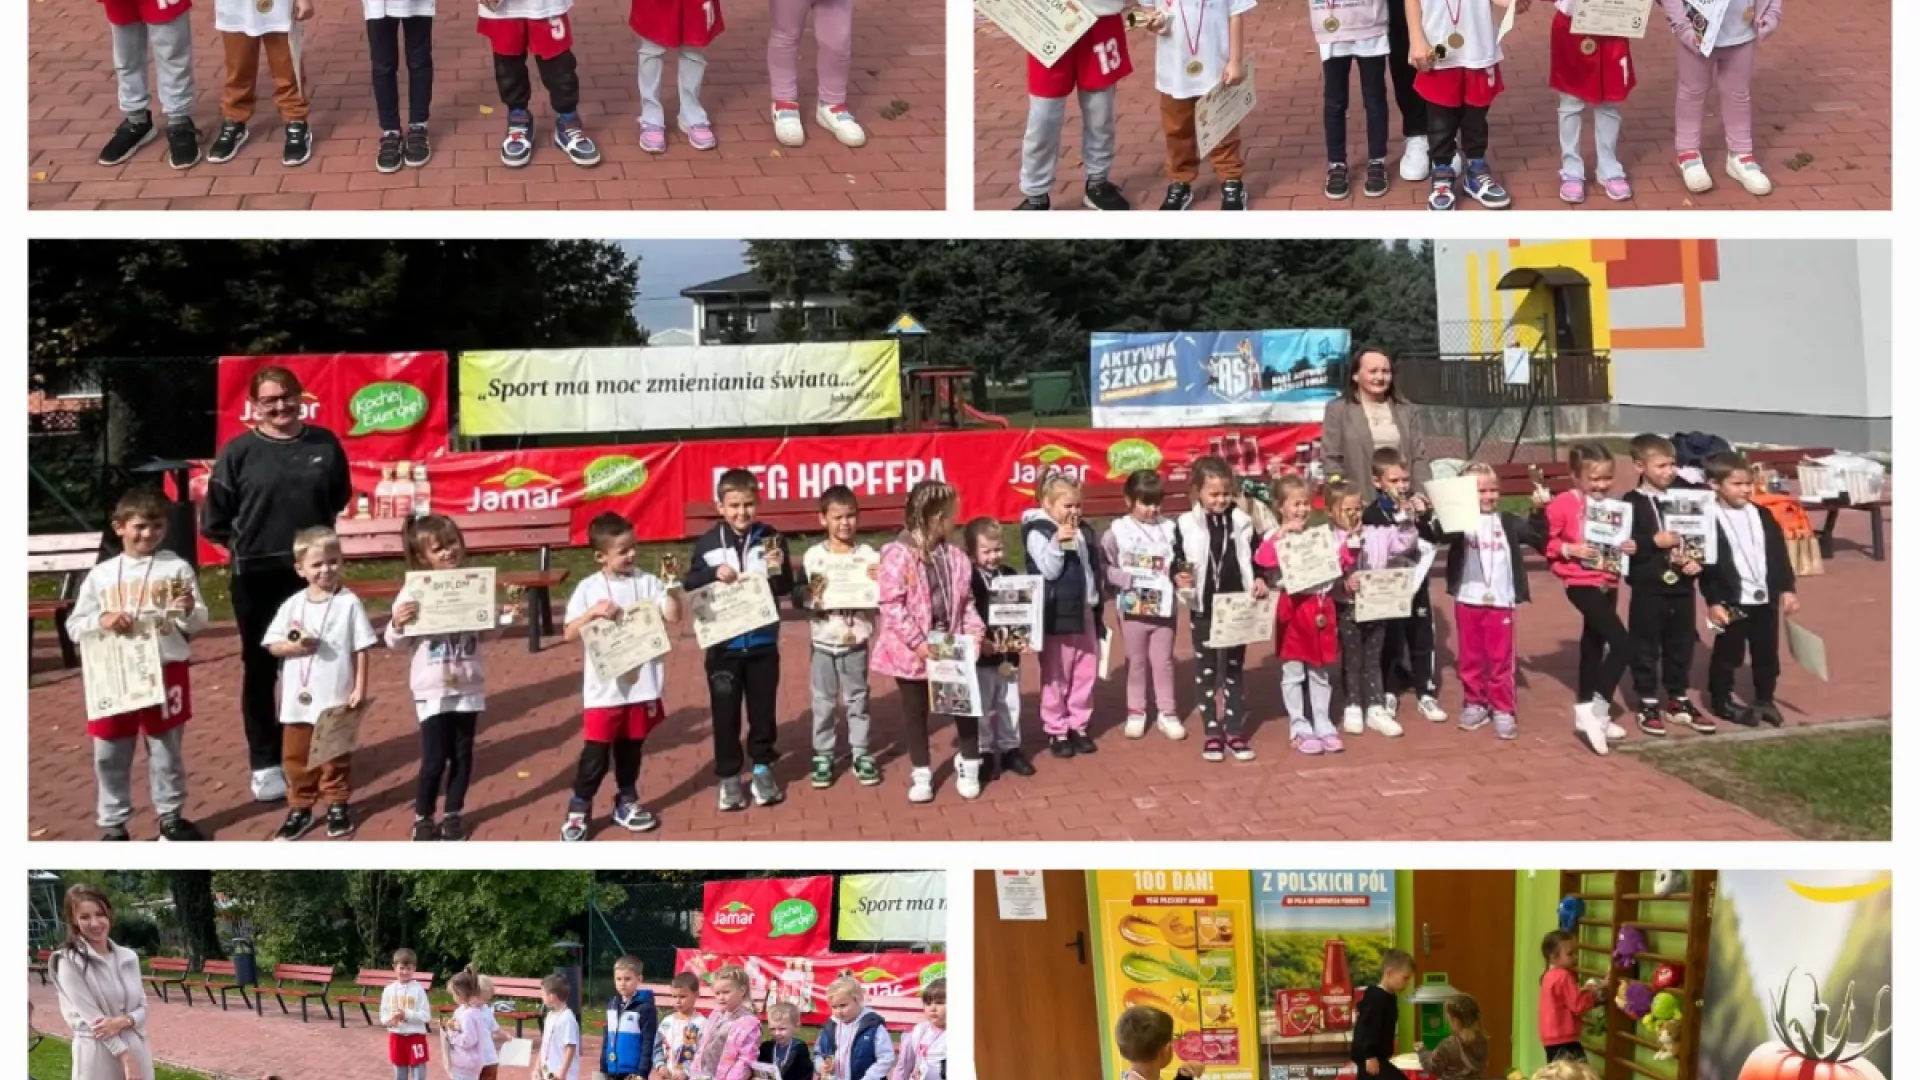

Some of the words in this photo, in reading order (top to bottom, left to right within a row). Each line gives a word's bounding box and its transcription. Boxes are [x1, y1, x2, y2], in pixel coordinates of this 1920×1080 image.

[1093, 38, 1122, 75] 13
[1100, 341, 1176, 369] AKTYWNA
[555, 381, 589, 396] ma
[596, 379, 641, 395] moc
[645, 372, 765, 394] zmieniania
[1100, 359, 1177, 391] SZKOŁA
[467, 487, 562, 512] Jamar
[1133, 870, 1166, 891] 100
[1262, 872, 1273, 892] Z
[1277, 872, 1354, 892] POLSKICH
[1358, 869, 1388, 892] PÓL
[906, 898, 935, 911] ma
[712, 911, 755, 925] Jamar
